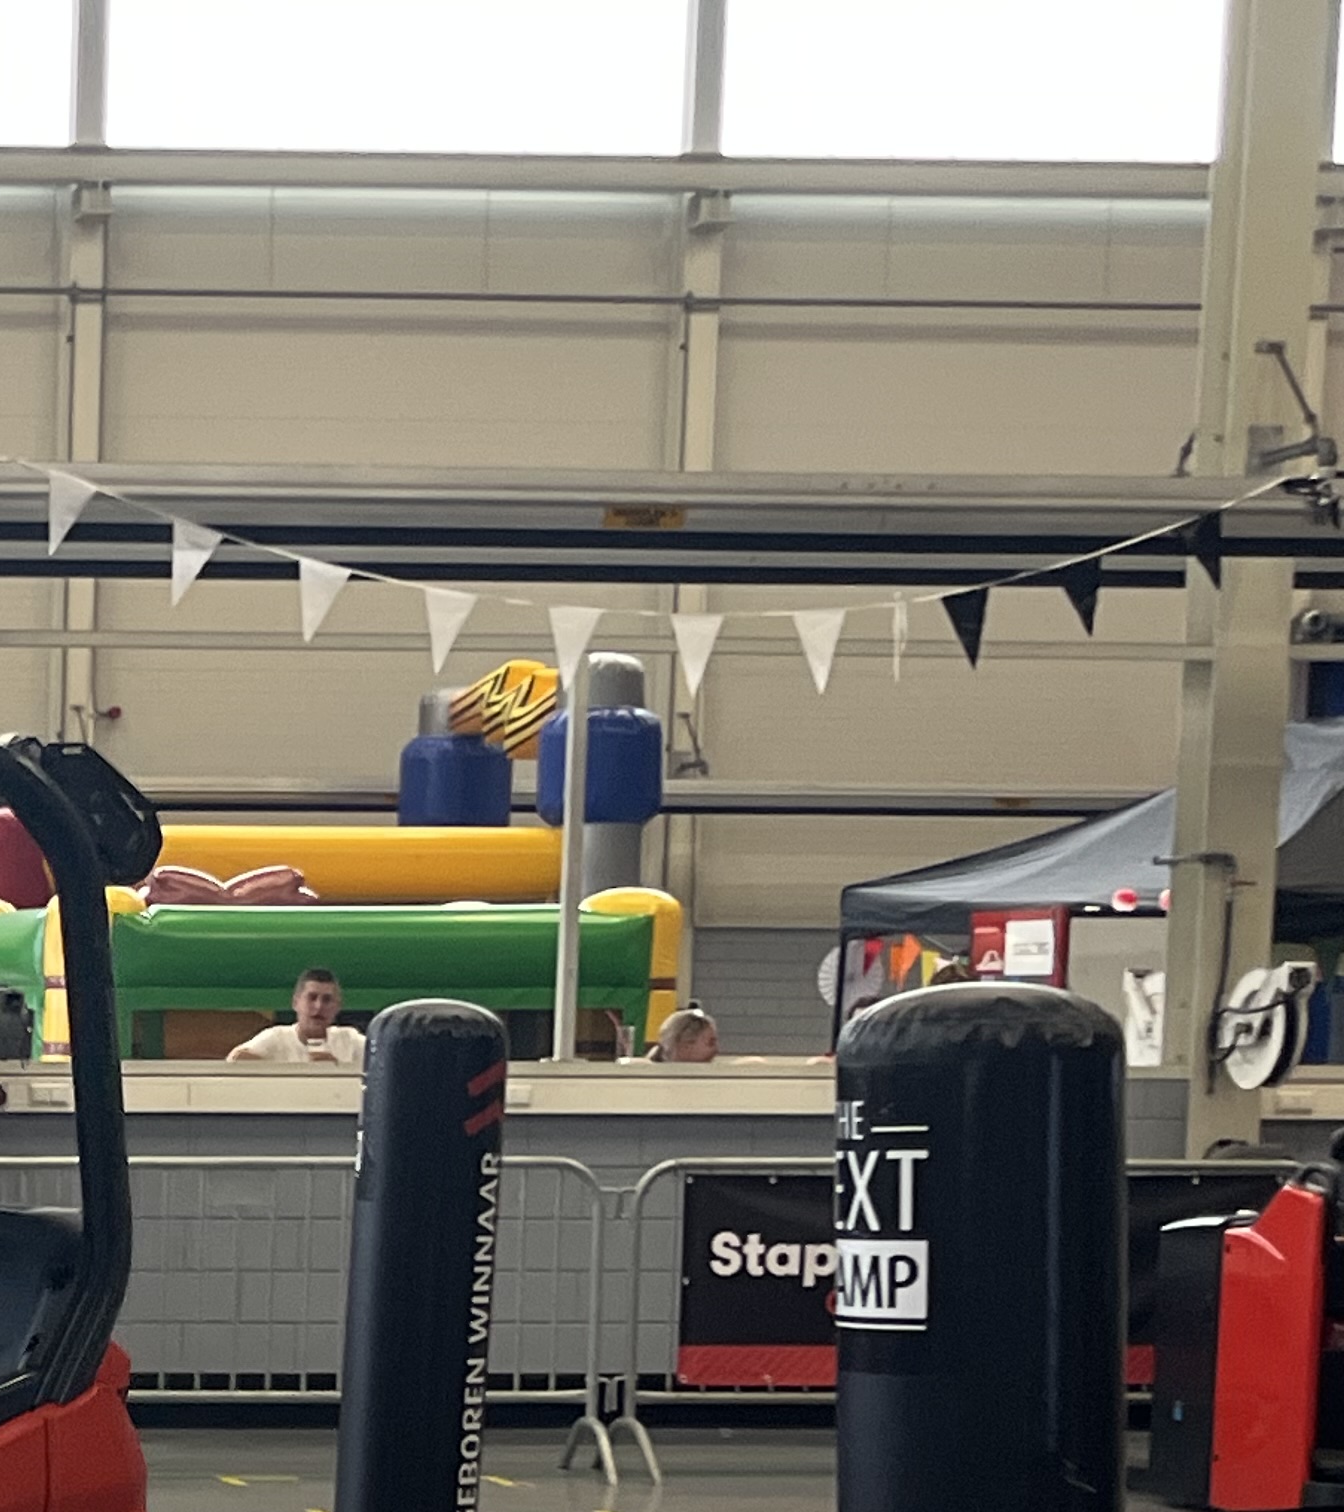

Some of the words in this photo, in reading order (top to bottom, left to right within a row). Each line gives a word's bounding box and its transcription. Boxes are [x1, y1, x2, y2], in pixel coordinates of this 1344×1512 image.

[835, 1100, 865, 1140] HE
[834, 1149, 930, 1232] EXT
[467, 1151, 500, 1345] WINNAAR
[709, 1231, 838, 1288] Stap
[836, 1252, 920, 1309] AMP
